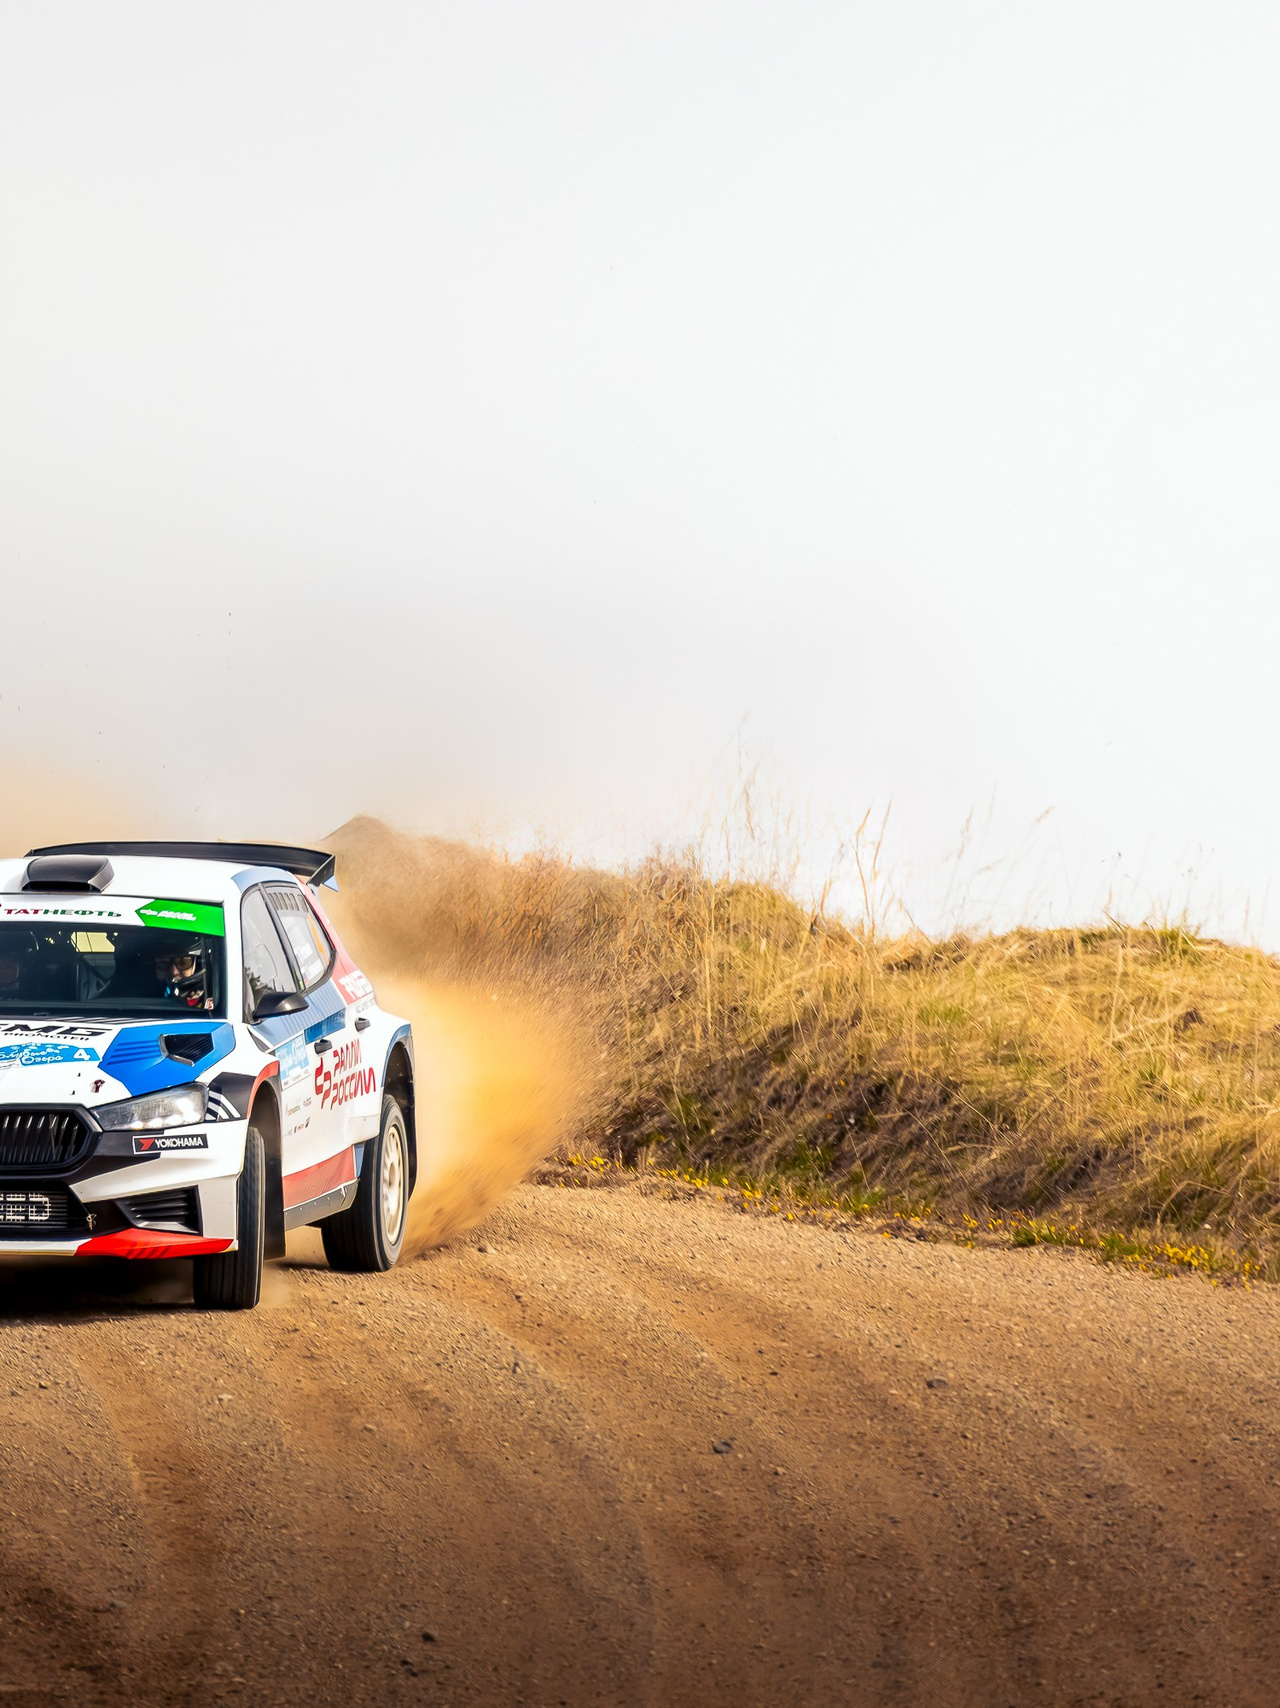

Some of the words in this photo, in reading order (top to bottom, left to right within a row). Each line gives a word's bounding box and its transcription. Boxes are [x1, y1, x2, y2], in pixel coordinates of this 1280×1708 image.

[3, 908, 122, 918] ТАТНЕФТЬ
[4, 1032, 90, 1041] PROMOTER
[73, 1048, 91, 1061] 4
[155, 1136, 204, 1148] YOKOHAMA
